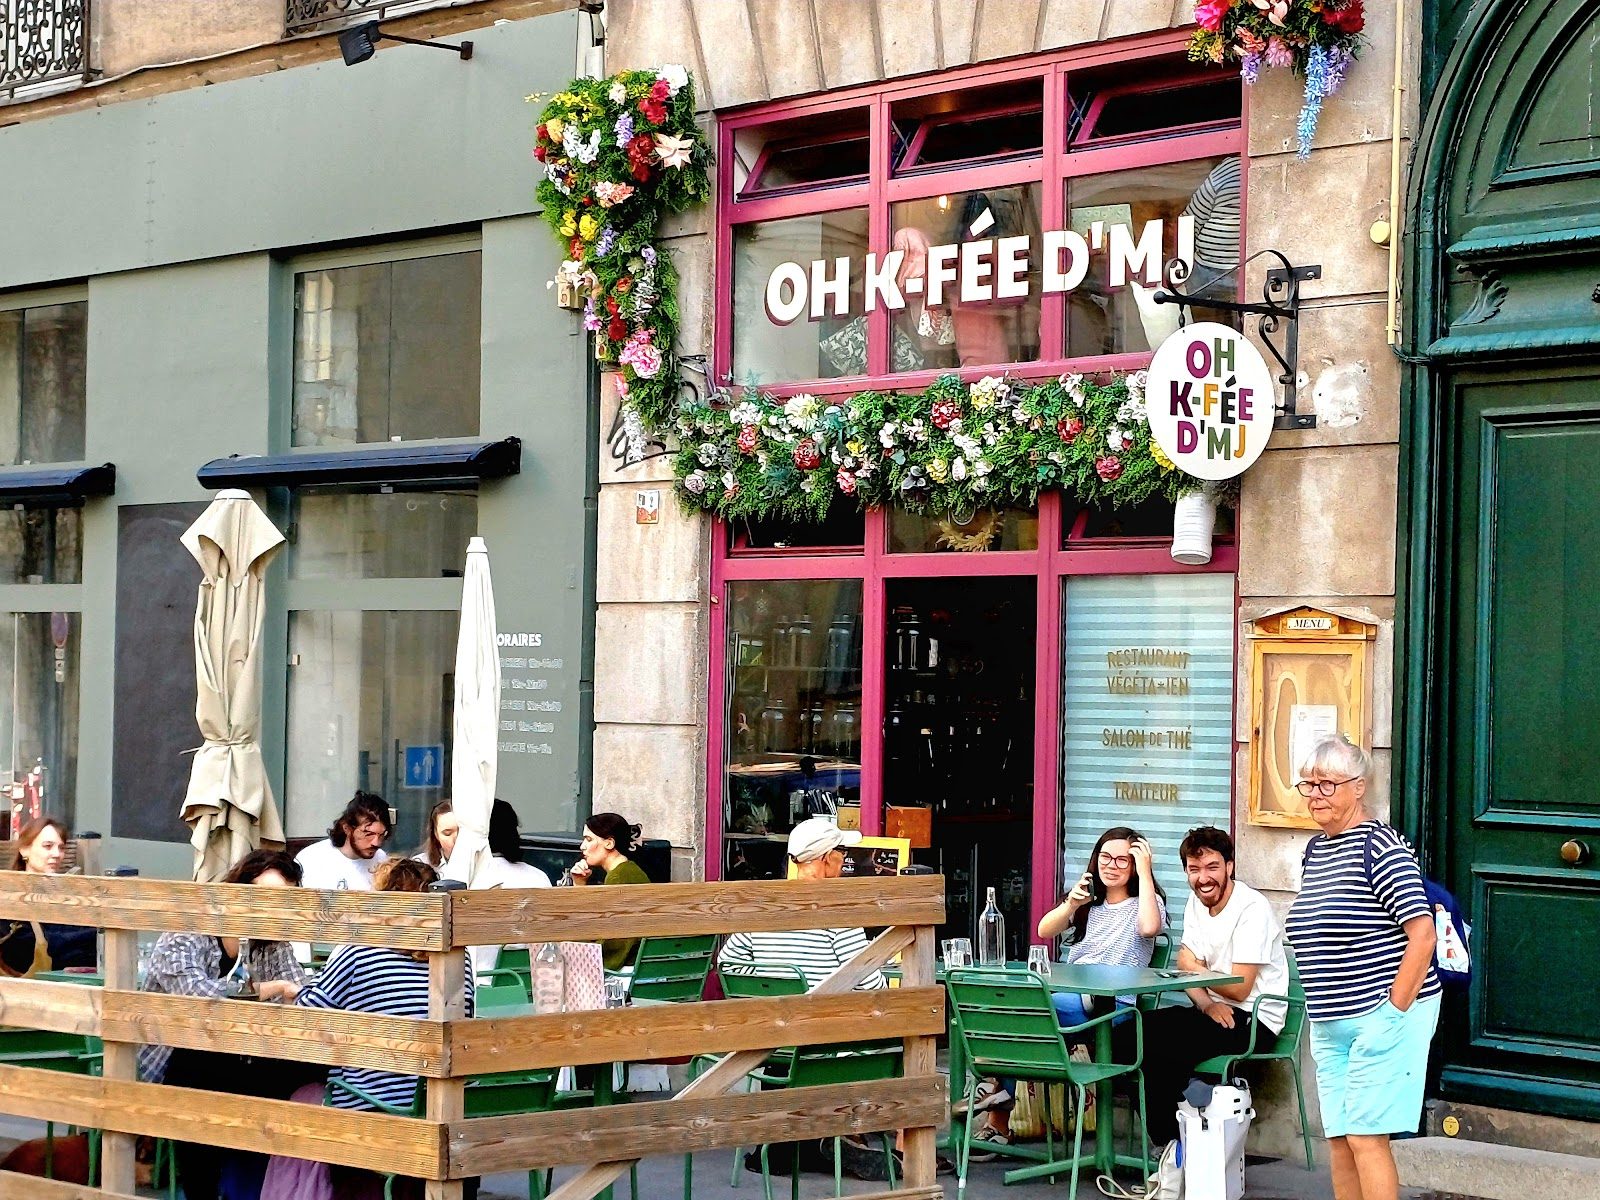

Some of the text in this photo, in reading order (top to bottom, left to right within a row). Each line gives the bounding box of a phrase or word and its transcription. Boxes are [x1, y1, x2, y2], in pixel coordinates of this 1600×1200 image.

[765, 206, 1195, 326] OH K-FÉE D'MJ
[1186, 337, 1235, 379] OH
[1169, 375, 1254, 424] K-FÉE
[1177, 419, 1246, 461] D'MJ
[1293, 618, 1326, 629] MENU
[496, 633, 542, 647] ORAIRES
[1106, 648, 1191, 669] RESTAURANT
[1102, 728, 1145, 748] SALON
[1167, 725, 1192, 750] THÉ
[1113, 781, 1179, 803] TRAITEUR
